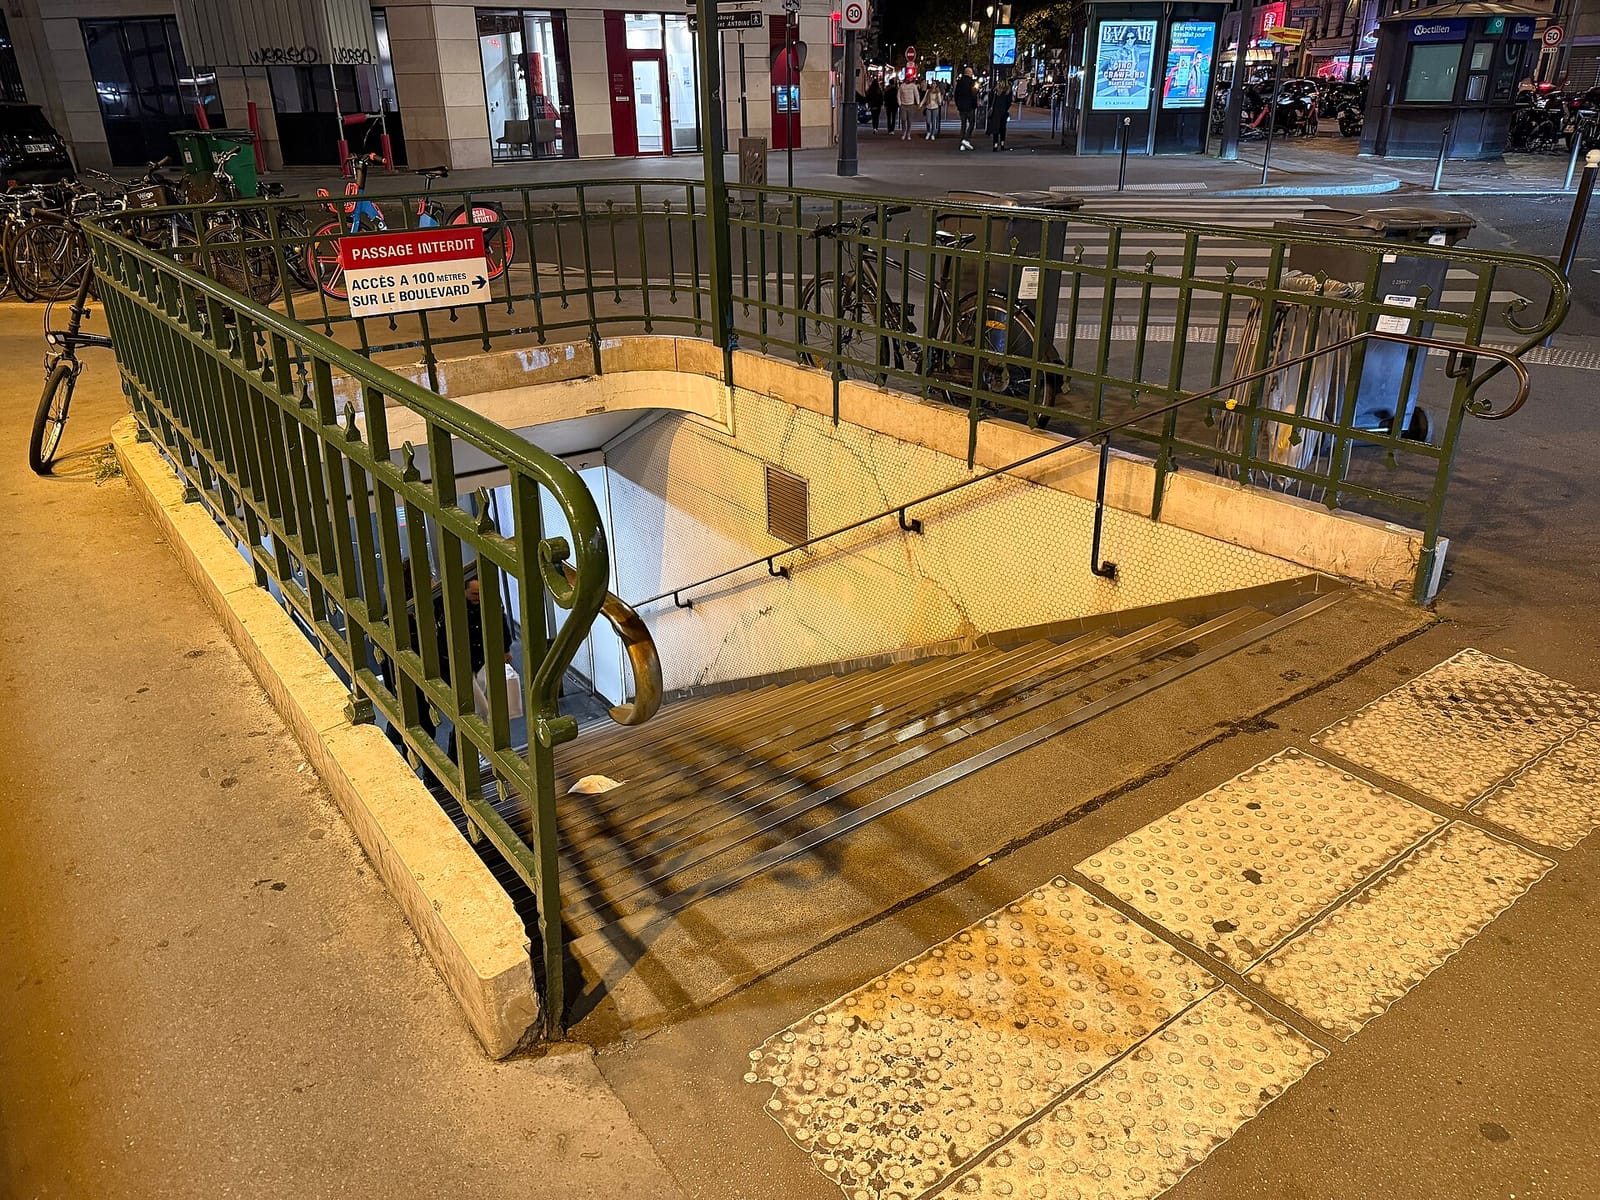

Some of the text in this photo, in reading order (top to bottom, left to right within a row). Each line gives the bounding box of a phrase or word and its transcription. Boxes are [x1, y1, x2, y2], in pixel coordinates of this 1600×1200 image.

[849, 9, 859, 18] 30
[1546, 32, 1559, 41] 50
[351, 238, 475, 261] PASSAGE INTERDIT
[351, 275, 395, 291] ACCÈS
[412, 272, 435, 285] 100
[352, 284, 470, 307] SUR LE BOULEVARD
